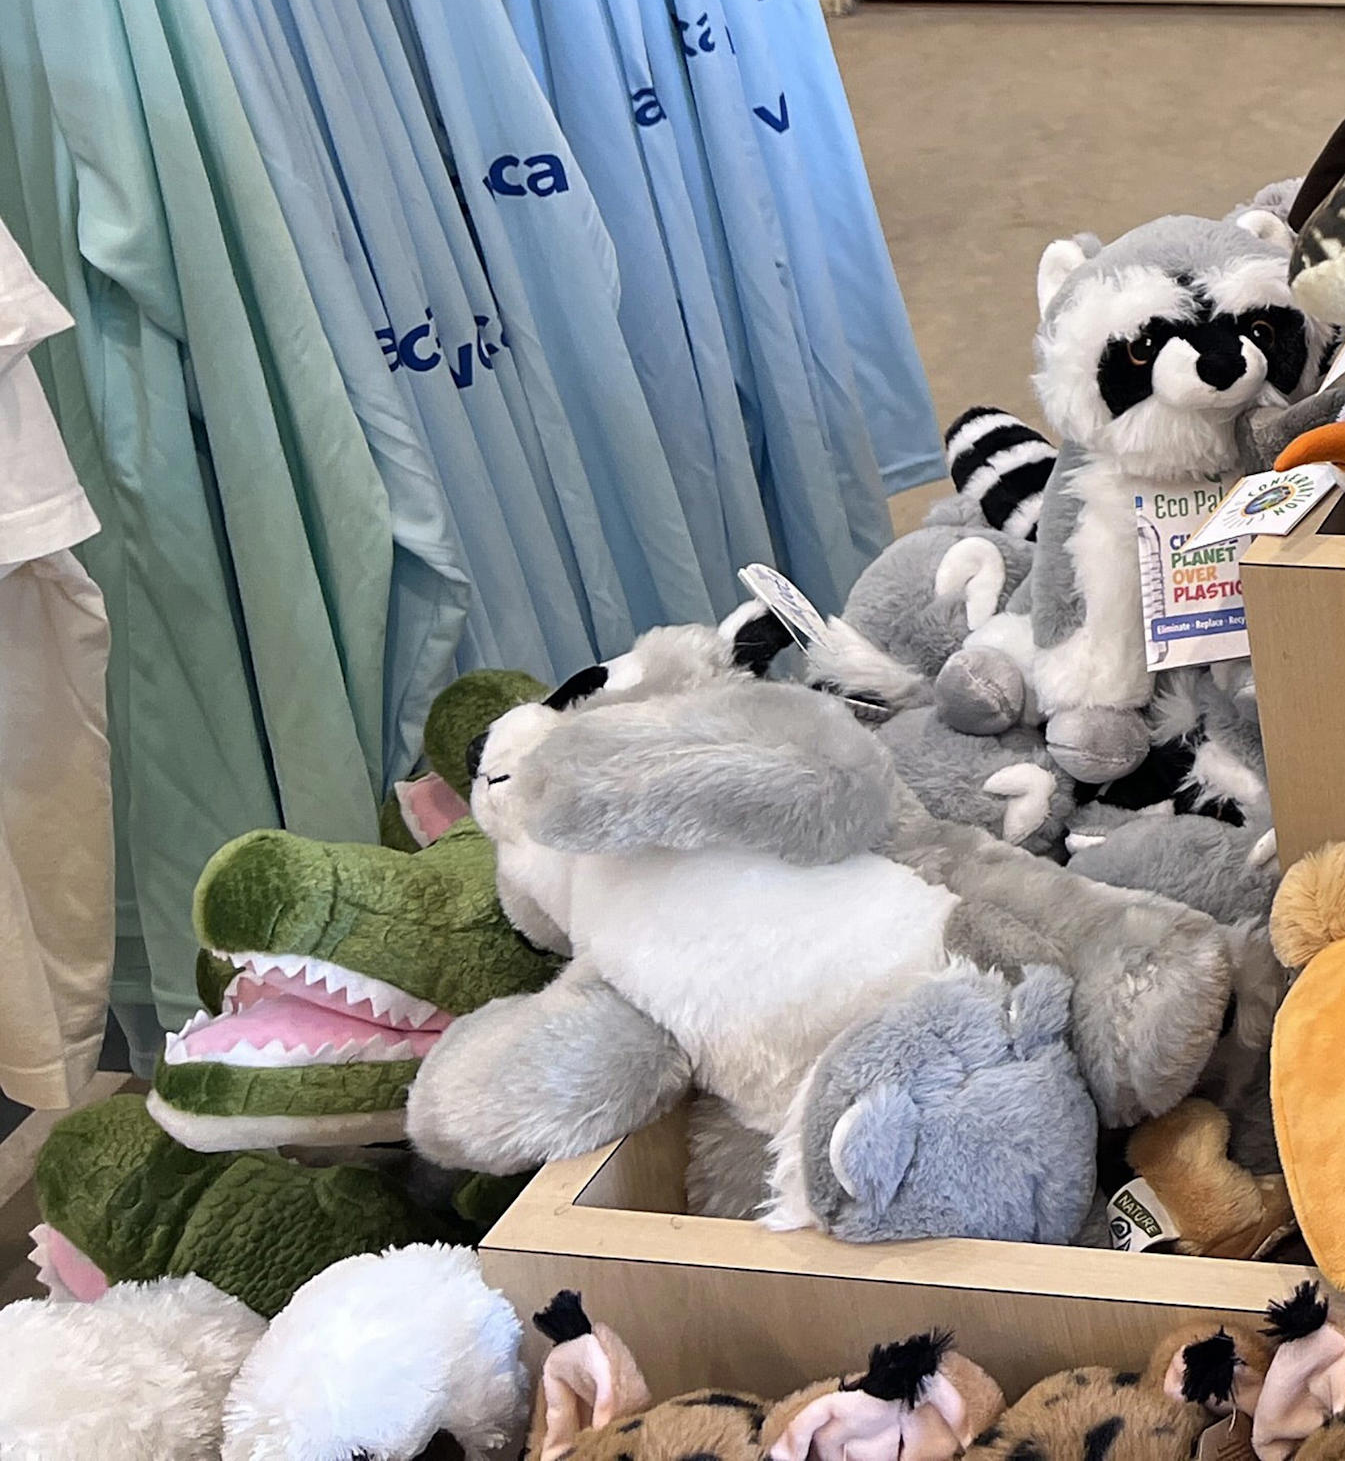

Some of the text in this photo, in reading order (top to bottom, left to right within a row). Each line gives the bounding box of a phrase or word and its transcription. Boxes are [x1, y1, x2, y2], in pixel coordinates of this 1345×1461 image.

[483, 153, 569, 199] ca
[1155, 493, 1189, 519] Eco
[1194, 486, 1225, 515] Pal
[1171, 545, 1237, 568] PLANET
[1172, 566, 1217, 585] OVER
[1174, 580, 1242, 603] PLASTIC
[1157, 615, 1245, 634] Eliminate Replace Recy
[1118, 1194, 1158, 1234] NATURE
